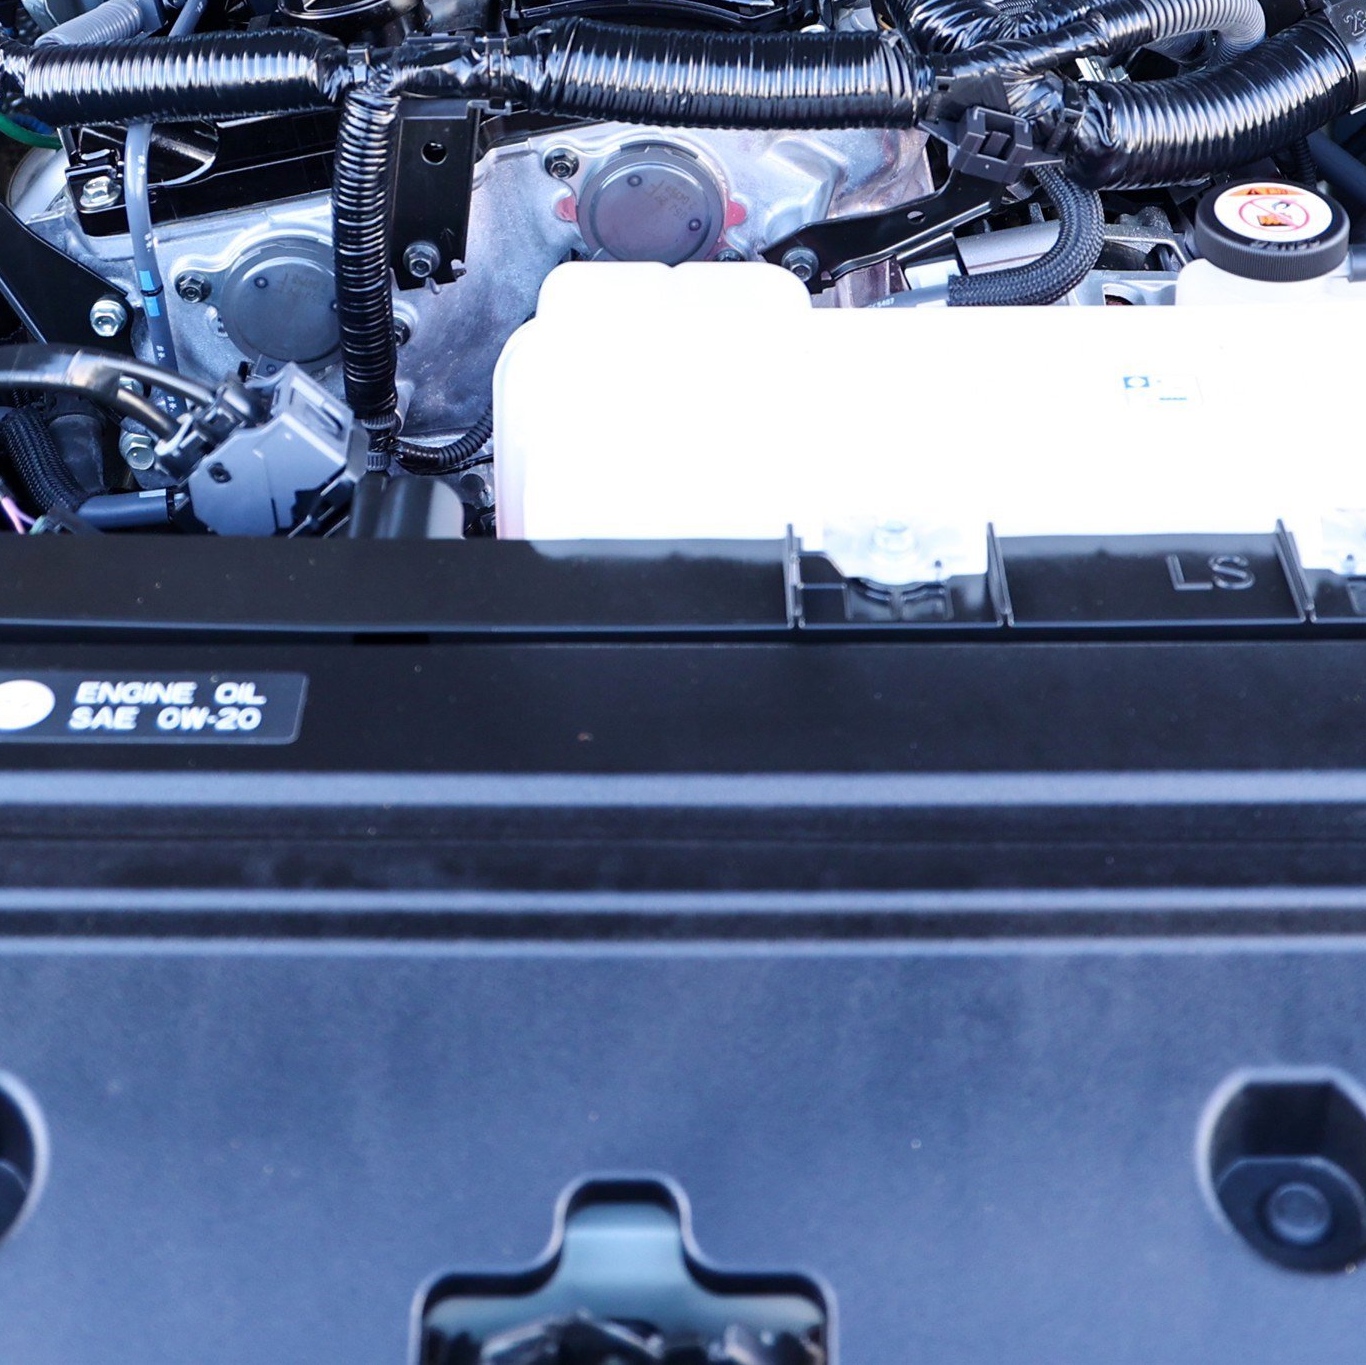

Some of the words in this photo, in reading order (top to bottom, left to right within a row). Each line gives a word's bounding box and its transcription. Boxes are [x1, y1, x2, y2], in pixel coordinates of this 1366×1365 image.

[1166, 553, 1256, 591] LS
[73, 681, 198, 705] ENGINE
[213, 682, 267, 706] OIL
[68, 706, 140, 730] SAE
[155, 706, 263, 731] 0W-20
